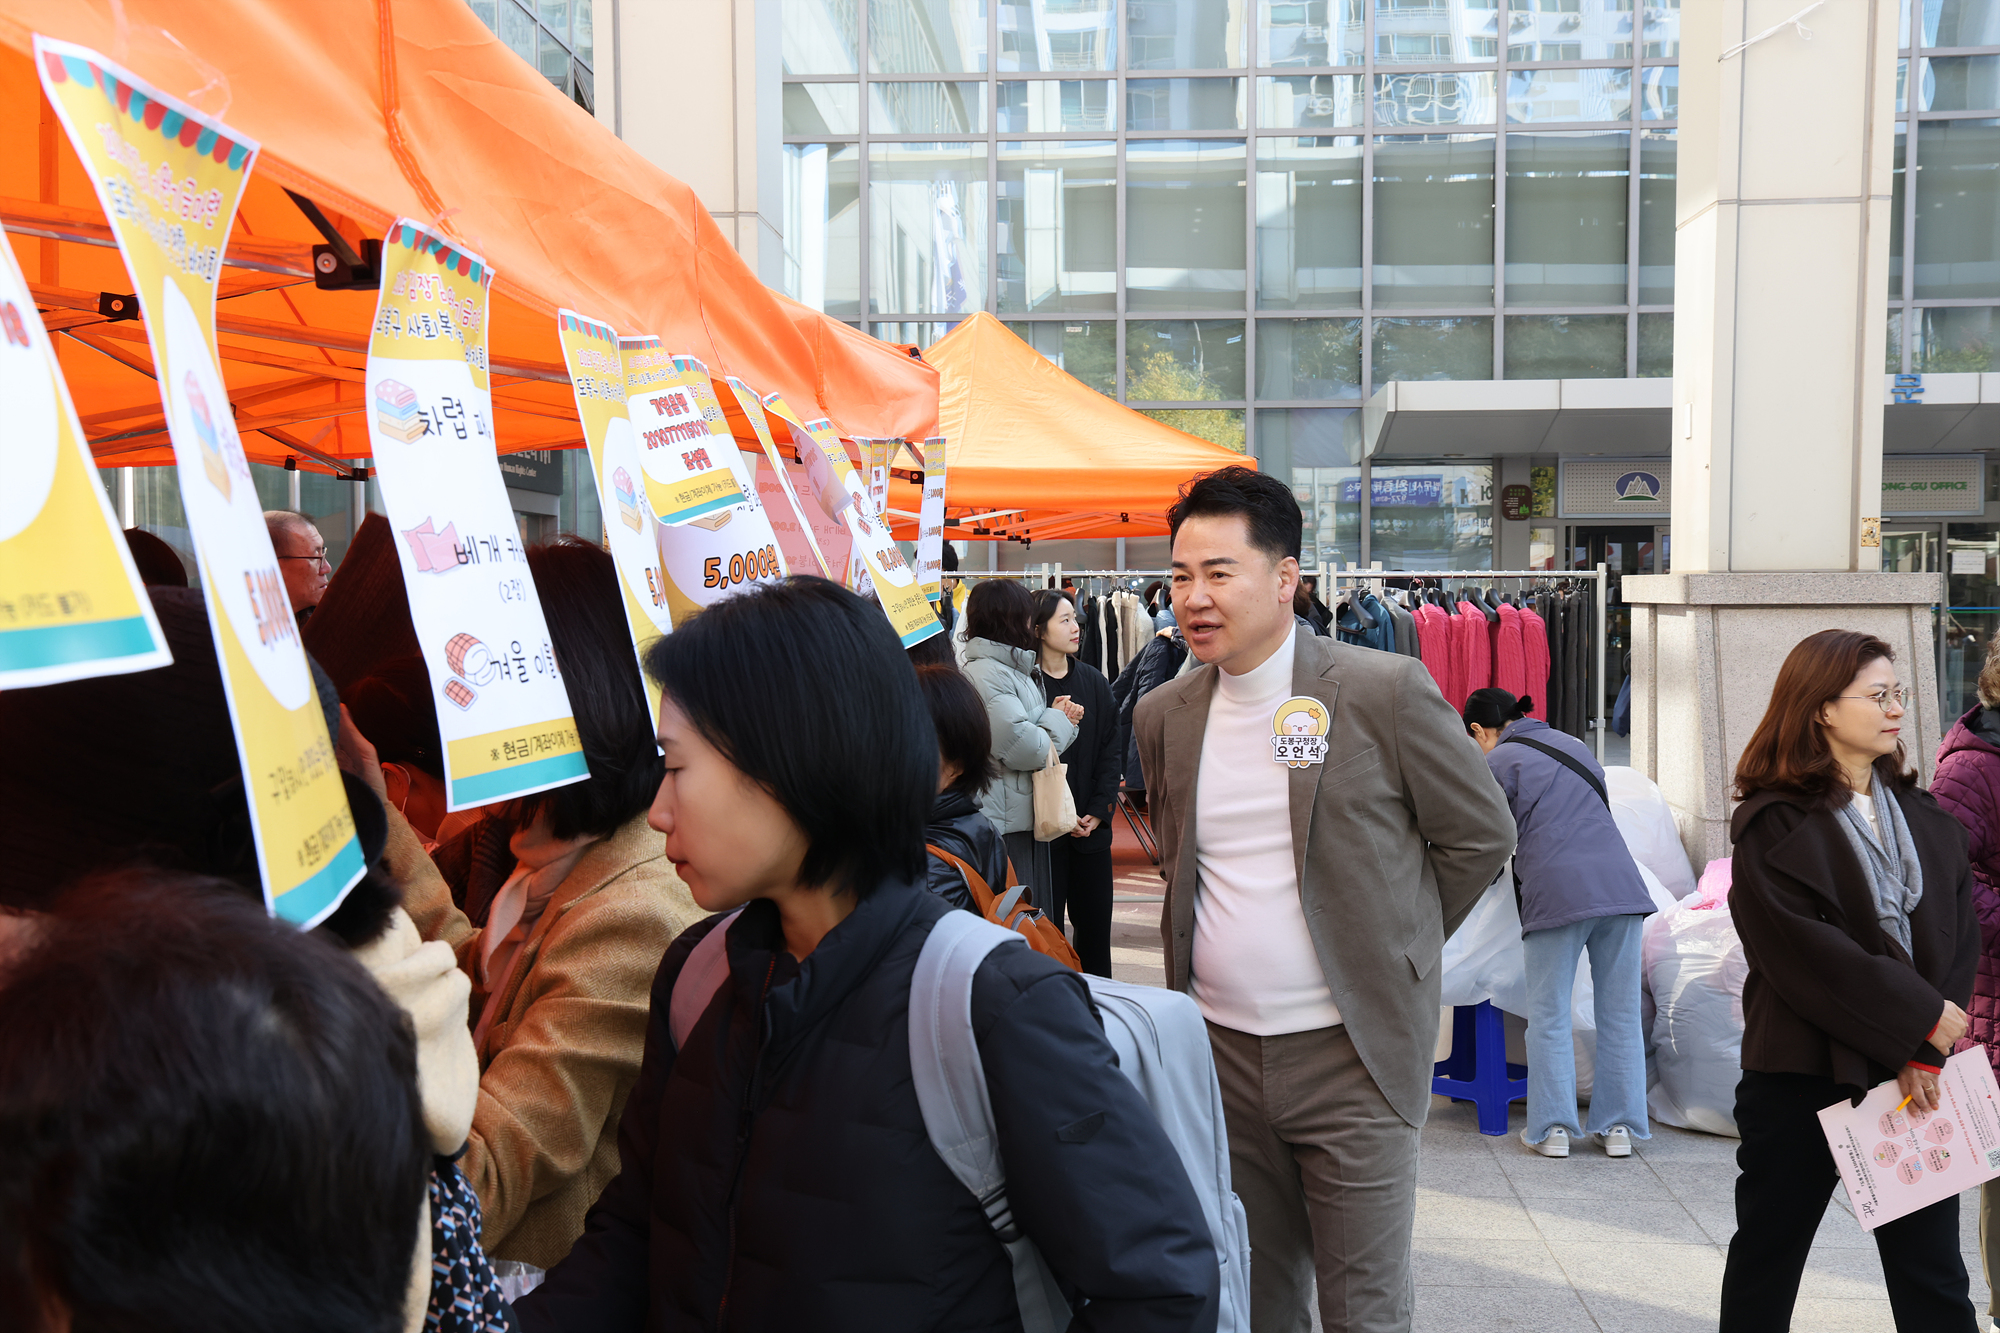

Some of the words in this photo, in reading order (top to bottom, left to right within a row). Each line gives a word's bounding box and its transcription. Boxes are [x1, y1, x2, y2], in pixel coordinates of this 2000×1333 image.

[575, 374, 600, 400] 도봉구
[1891, 374, 1924, 404] 문
[417, 396, 468, 440] 차렵
[649, 392, 690, 418] 기업은행
[1881, 481, 1928, 491] ONG-GU
[1930, 481, 1968, 491] OFFICE
[453, 534, 503, 565] 베개
[704, 544, 782, 590] 5,000원
[498, 577, 526, 604] (2장)
[490, 640, 530, 684] 겨울
[1280, 737, 1317, 745] 도봉구청장
